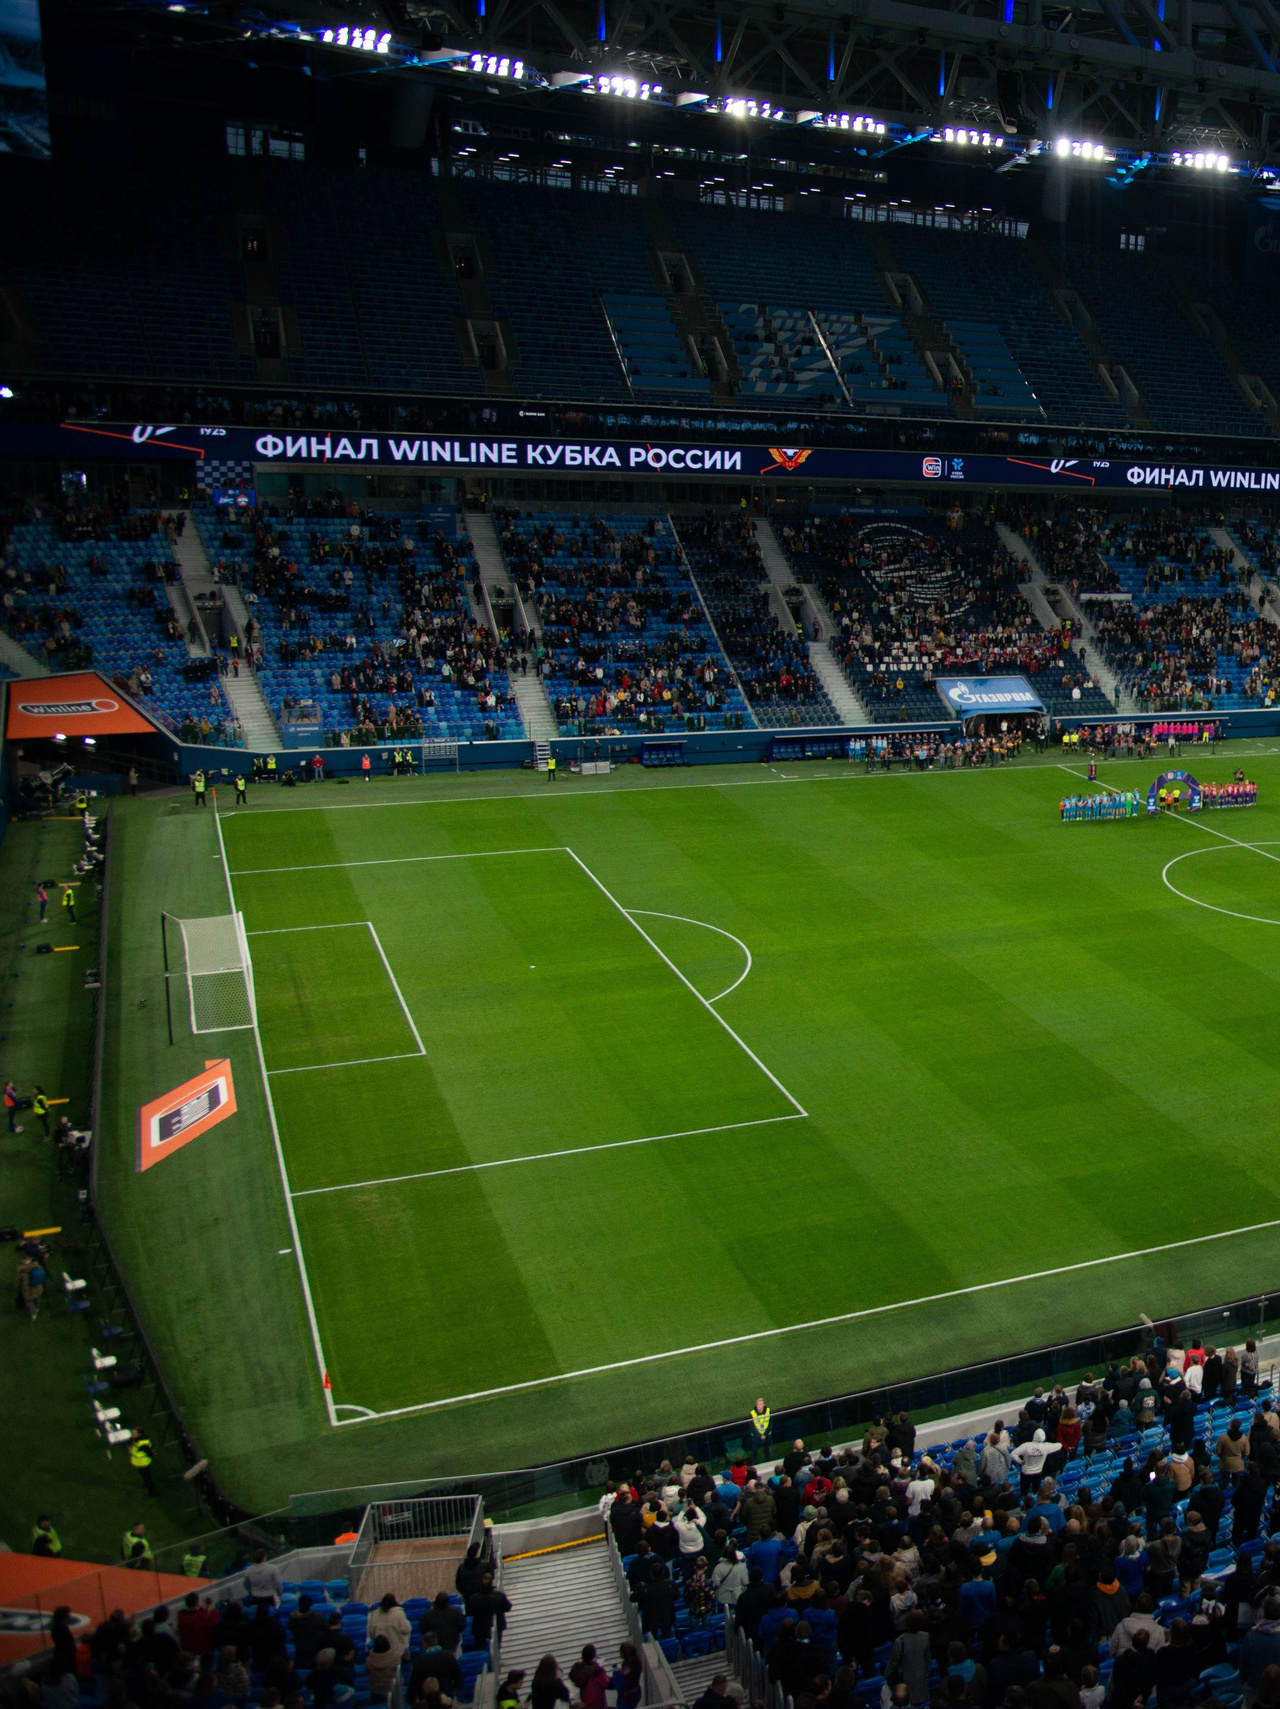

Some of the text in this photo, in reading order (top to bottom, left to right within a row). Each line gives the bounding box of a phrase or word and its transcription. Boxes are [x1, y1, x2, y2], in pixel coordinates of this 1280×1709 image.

[255, 434, 741, 470] ФИНАЛ WINLINE КУБКА РОССИИ
[1126, 466, 1205, 487] ФИНАЛ
[974, 692, 1034, 703] ГАЗПРОМ
[27, 704, 92, 714] Winline
